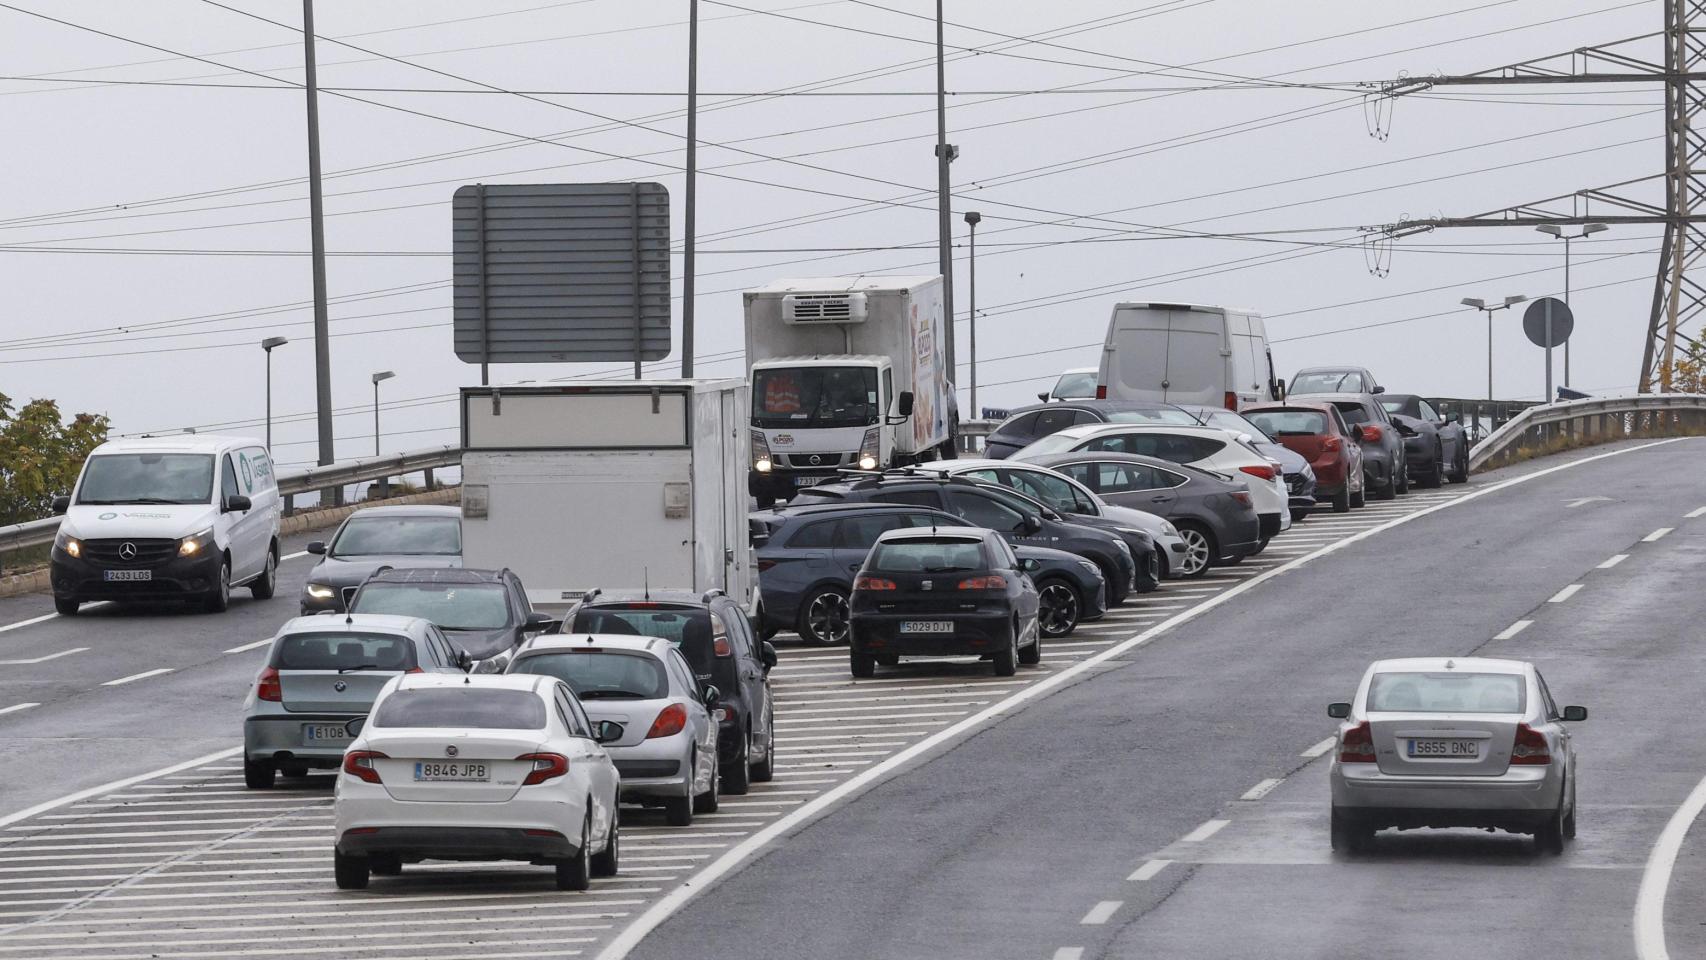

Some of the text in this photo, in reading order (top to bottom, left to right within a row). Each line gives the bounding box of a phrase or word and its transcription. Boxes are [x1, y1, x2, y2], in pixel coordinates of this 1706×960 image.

[110, 571, 150, 580] 2433 LDS
[906, 622, 952, 632] 5029 DJY
[1416, 742, 1447, 754] 5655
[424, 764, 486, 777] 8846 JPB
